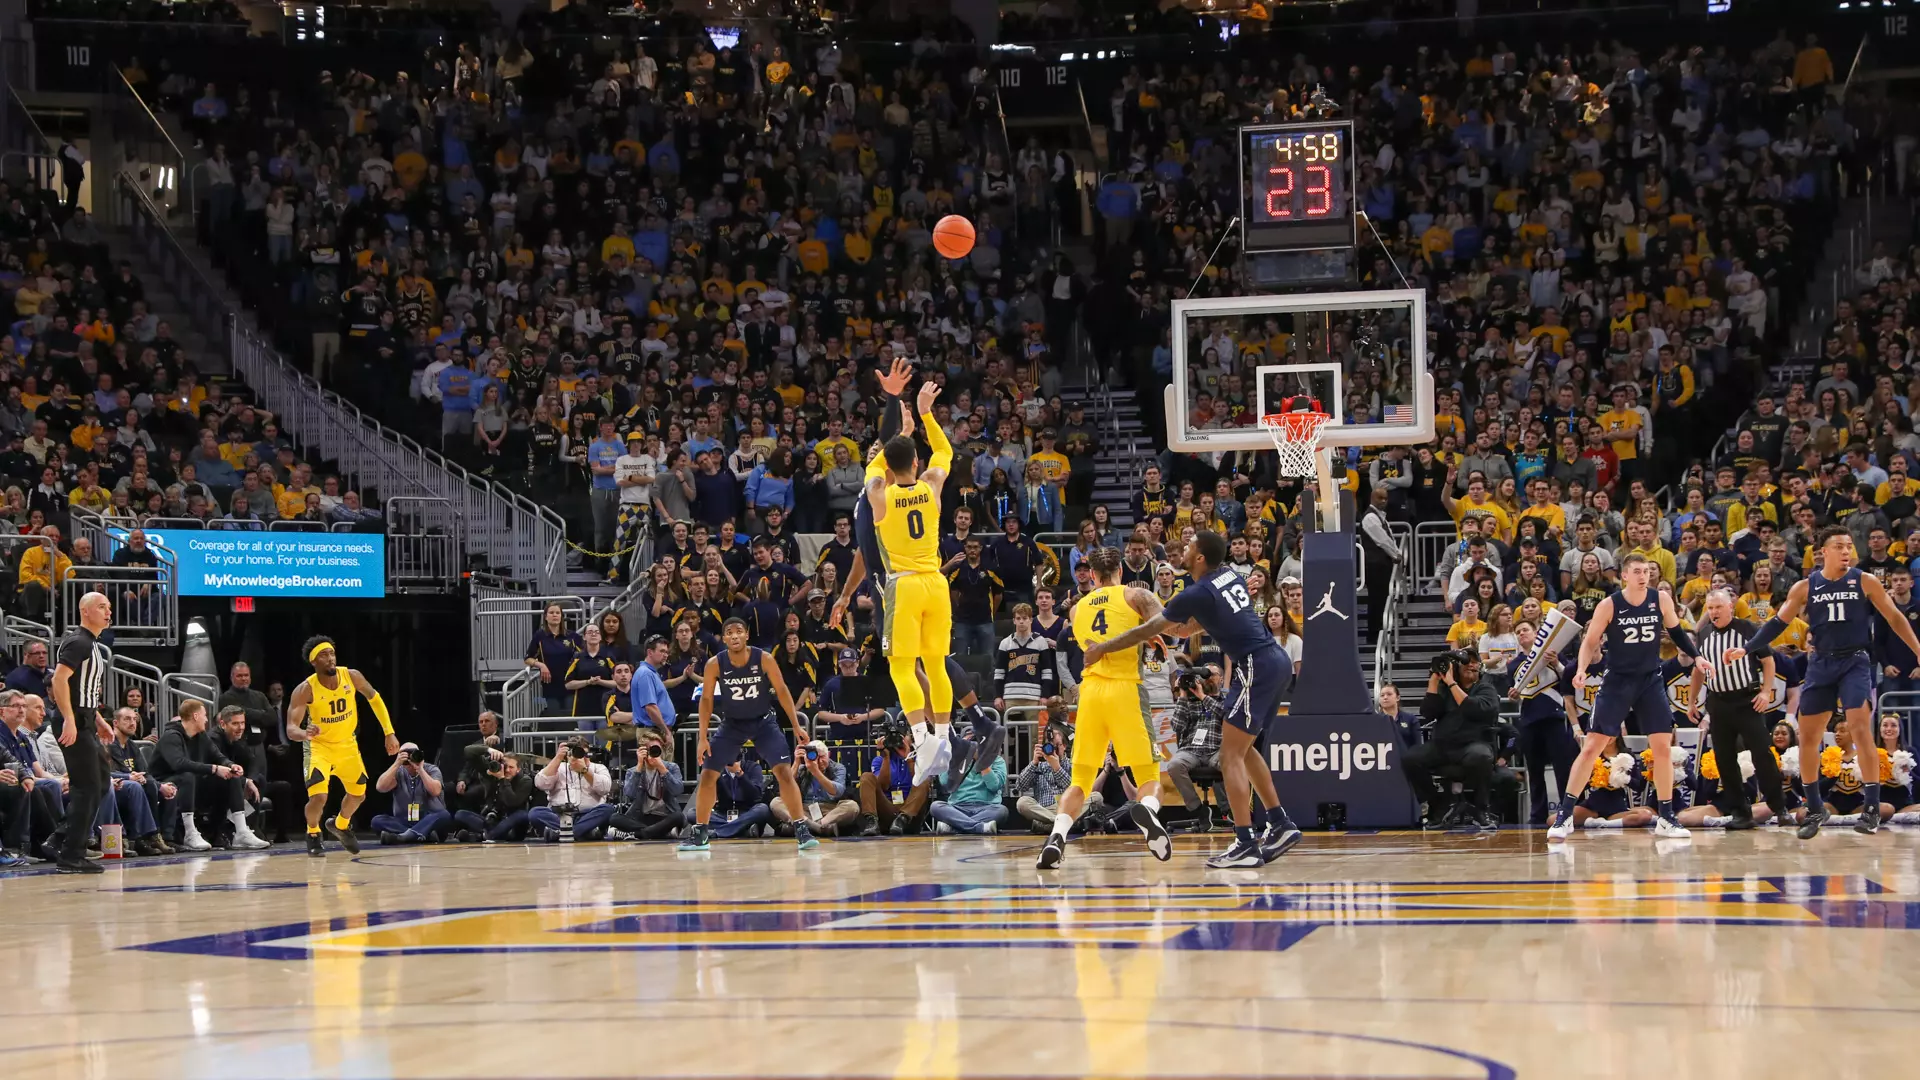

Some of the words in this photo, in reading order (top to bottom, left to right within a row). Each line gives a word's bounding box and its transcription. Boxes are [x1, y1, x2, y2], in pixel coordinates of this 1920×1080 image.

[1884, 15, 1908, 36] 112
[66, 45, 90, 66] 110
[1000, 67, 1021, 88] 110
[1045, 65, 1067, 85] 112
[1275, 133, 1338, 161] 4:58
[1265, 165, 1331, 217] 23
[624, 361, 632, 371] 3
[895, 493, 929, 508] HOWARD
[907, 509, 925, 540] 0
[189, 539, 235, 552] Coverage
[236, 540, 249, 551] for
[251, 540, 262, 551] all
[263, 540, 274, 551] of
[275, 543, 296, 554] your
[298, 541, 342, 553] insurance
[205, 553, 221, 565] For
[222, 555, 243, 567] your
[245, 554, 275, 565] home.
[277, 554, 294, 566] For
[295, 557, 315, 567] your
[317, 555, 361, 567] business.
[204, 573, 362, 590] MyKnowledgeBroker.com
[235, 597, 253, 610] EXIT
[1089, 595, 1109, 606] JOHN
[1221, 583, 1250, 614] 13
[1812, 591, 1859, 604] XAVIER
[1617, 615, 1659, 627] XAVIER
[1827, 602, 1847, 622] 11
[1091, 609, 1109, 636] 4
[1623, 625, 1656, 644] 25
[723, 676, 762, 685] XAVIER
[729, 684, 760, 701] 24
[328, 697, 347, 716] 10
[1270, 732, 1393, 780] meijer
